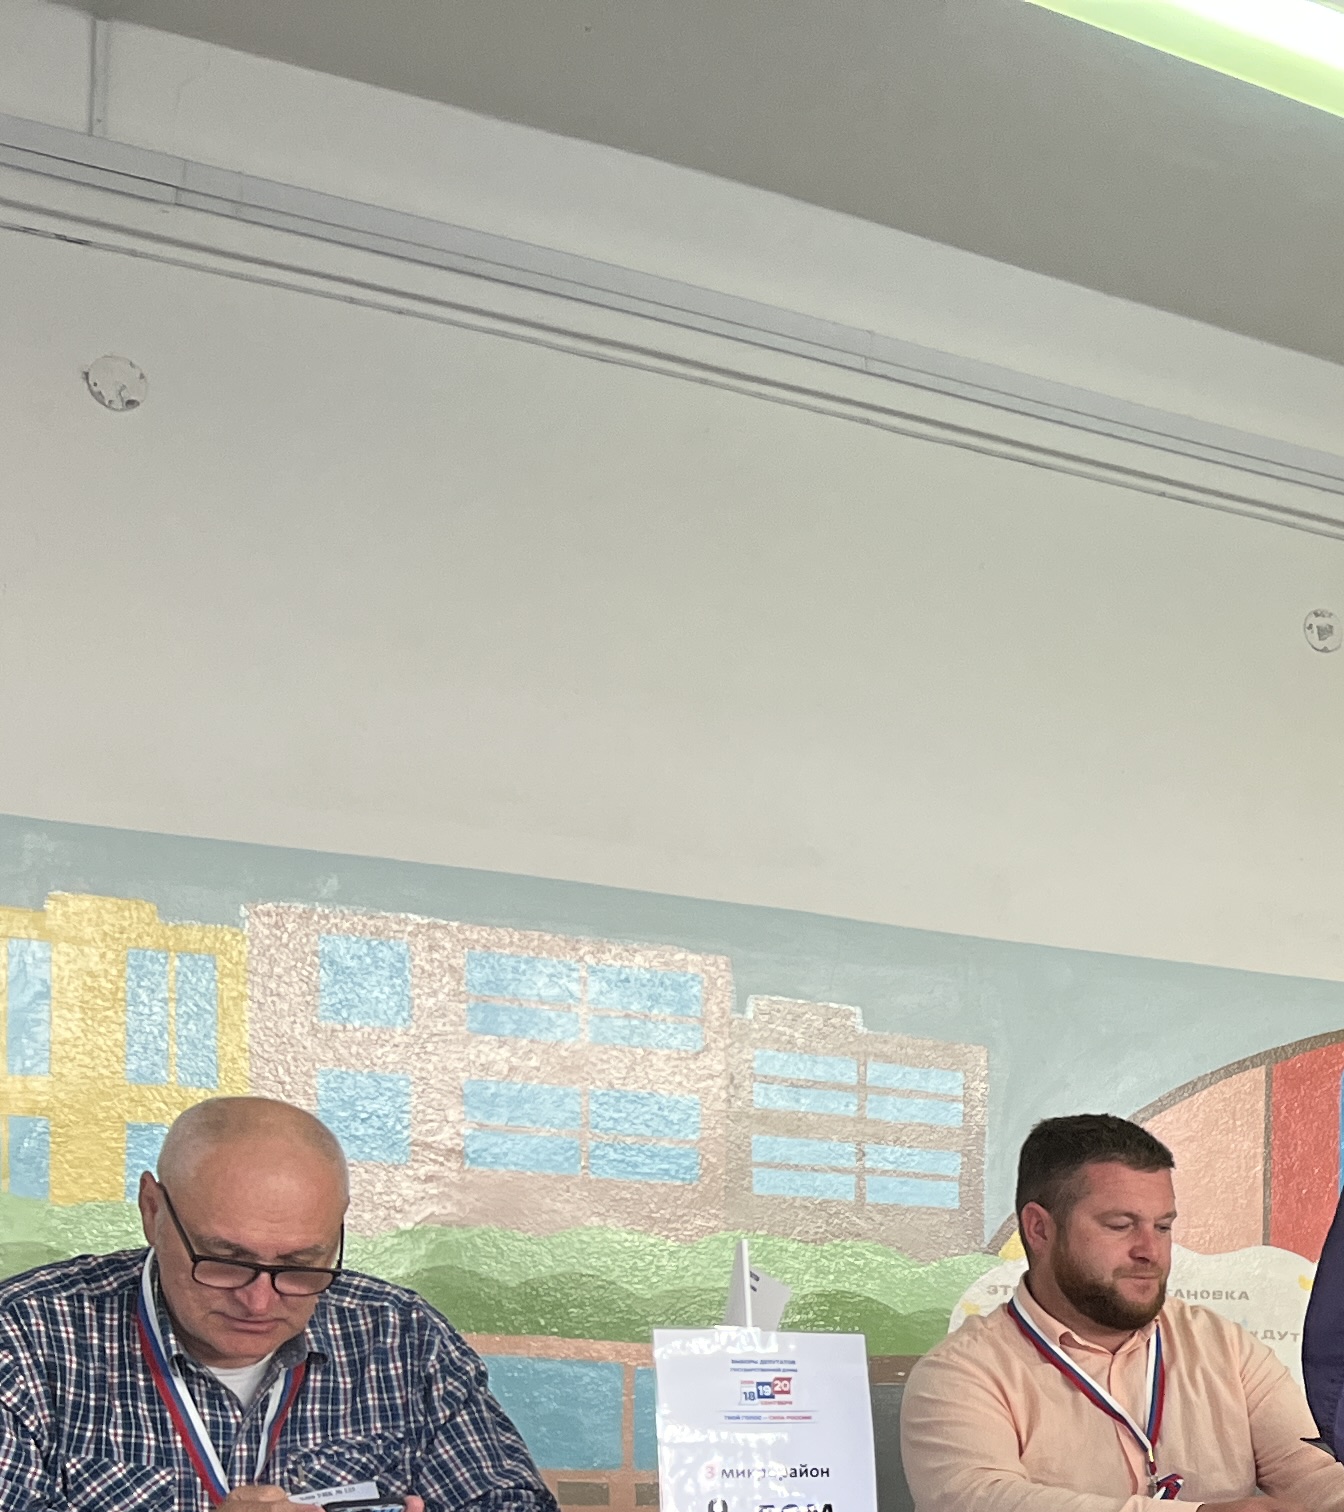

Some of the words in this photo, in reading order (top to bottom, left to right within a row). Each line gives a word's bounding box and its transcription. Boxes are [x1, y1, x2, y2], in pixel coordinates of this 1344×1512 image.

[1166, 1288, 1250, 1301] АНОВКА
[743, 1391, 756, 1401] 18
[757, 1385, 771, 1396] 19
[774, 1380, 790, 1392] 20
[722, 1464, 830, 1481] микайон
